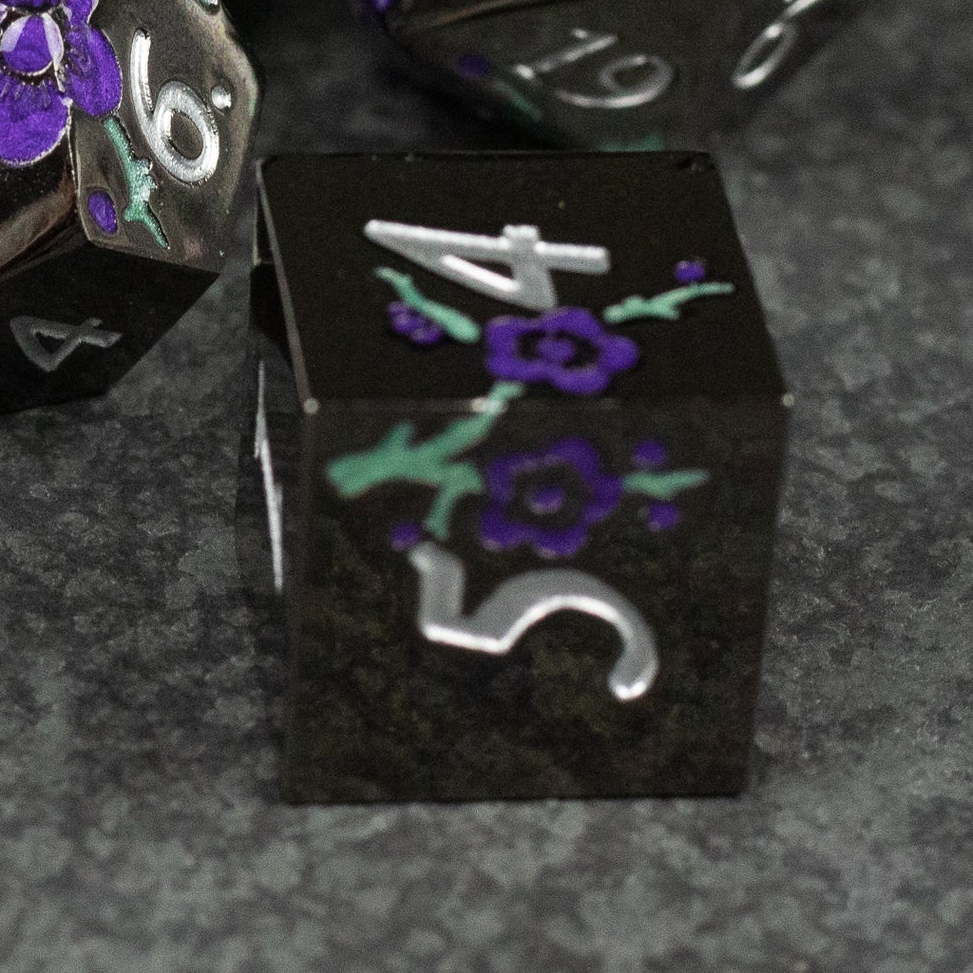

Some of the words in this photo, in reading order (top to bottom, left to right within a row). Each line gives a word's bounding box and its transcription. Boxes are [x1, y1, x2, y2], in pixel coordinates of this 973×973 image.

[364, 219, 611, 312] 4
[9, 315, 125, 374] 4
[407, 539, 660, 701] 5
